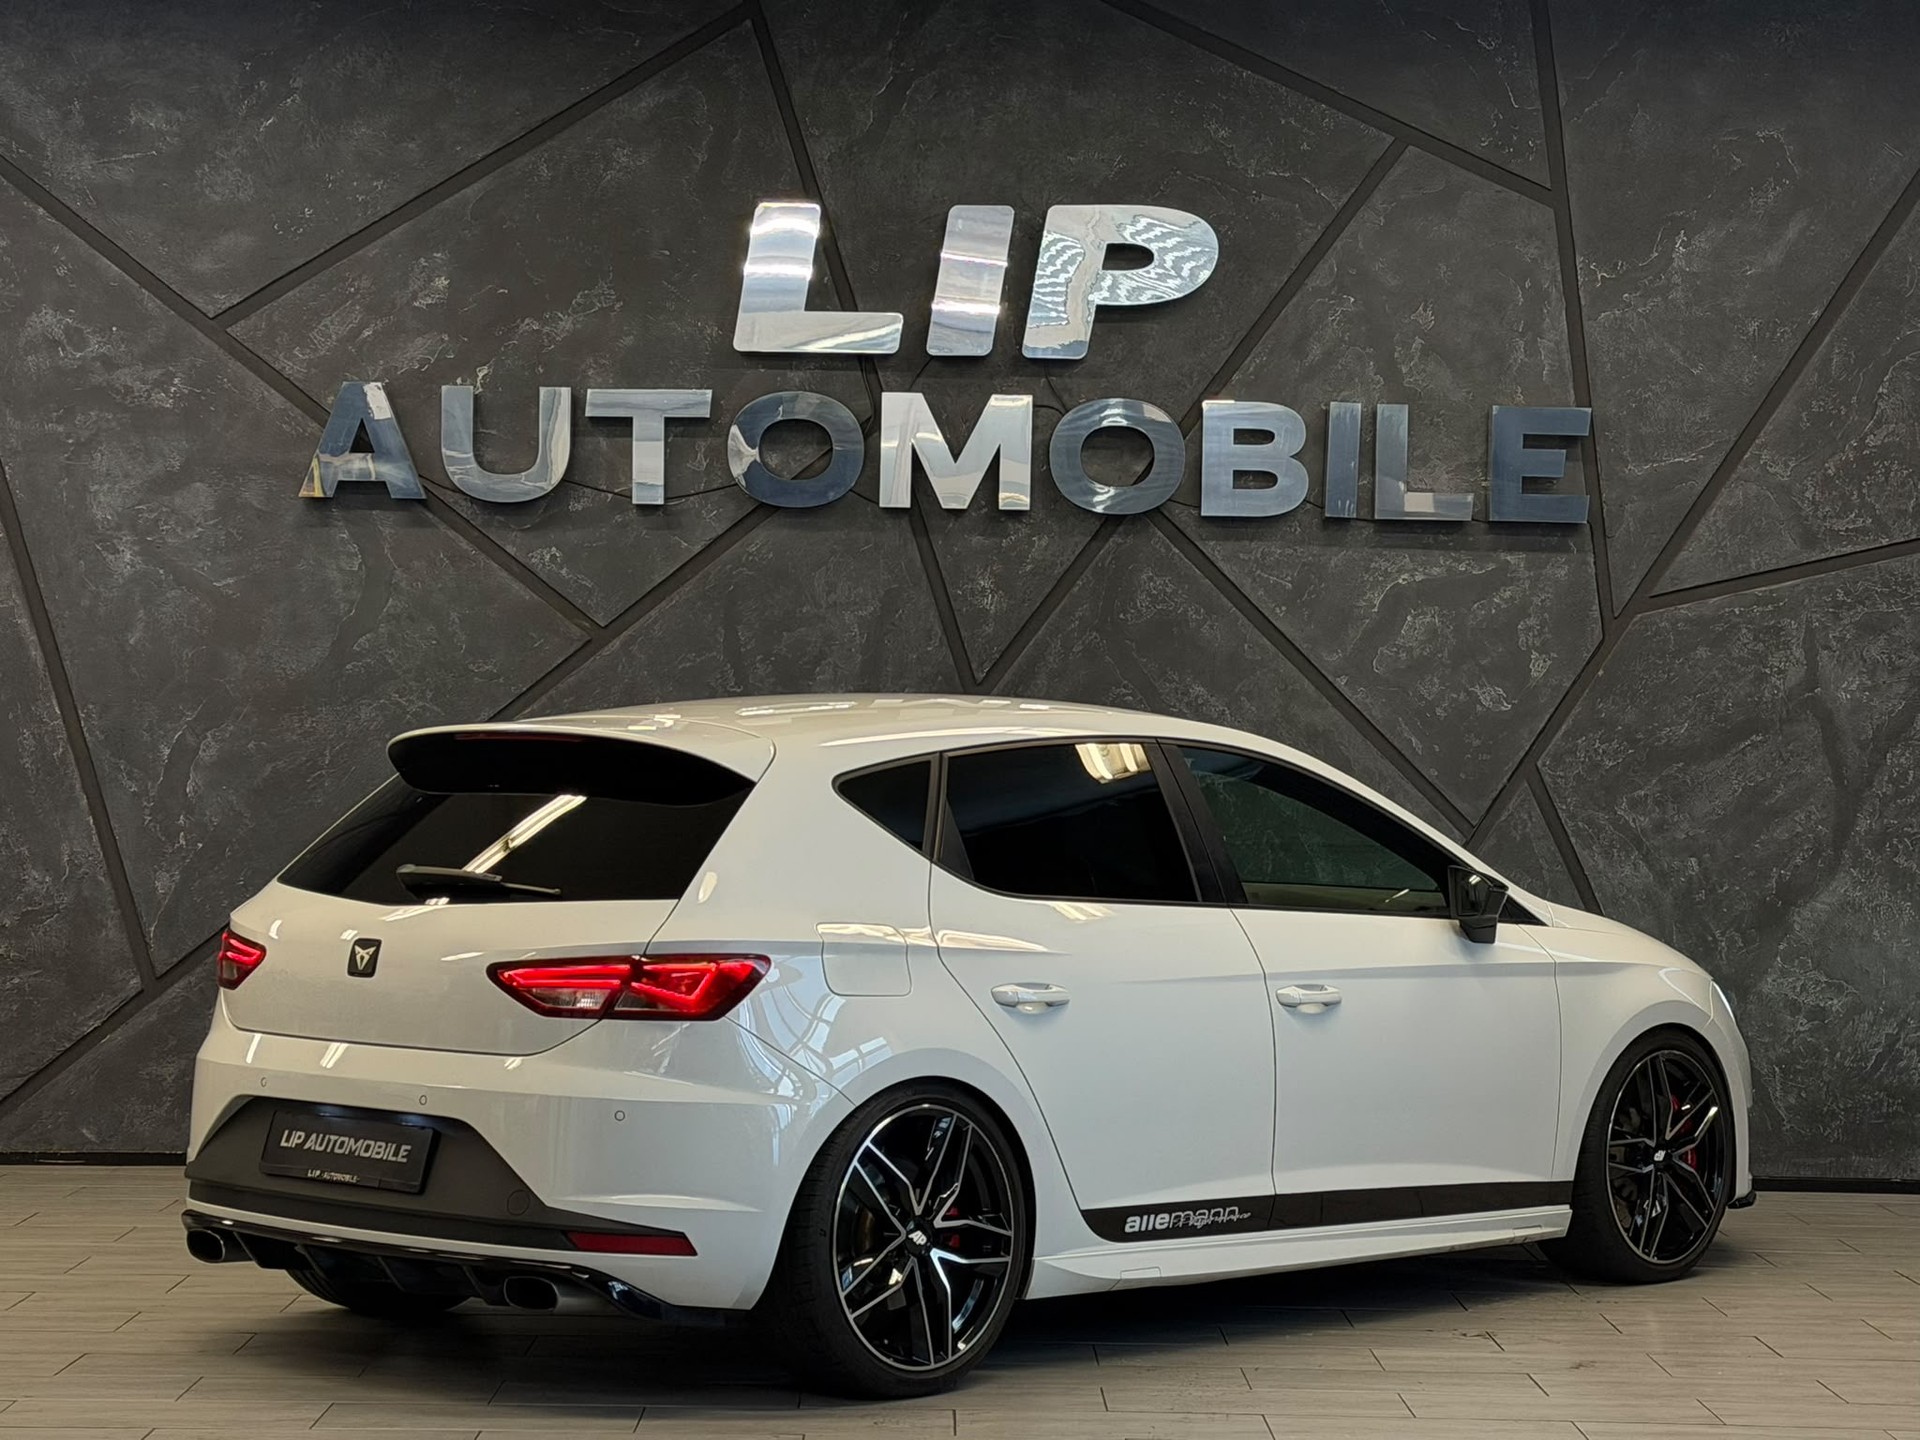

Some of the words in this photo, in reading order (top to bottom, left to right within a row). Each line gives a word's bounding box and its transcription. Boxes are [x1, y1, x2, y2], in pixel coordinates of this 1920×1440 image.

[733, 202, 1220, 359] LIP
[299, 381, 1592, 524] AUTOMOBILE
[280, 1129, 305, 1149] LIP
[304, 1133, 412, 1163] AUTOMOBILE
